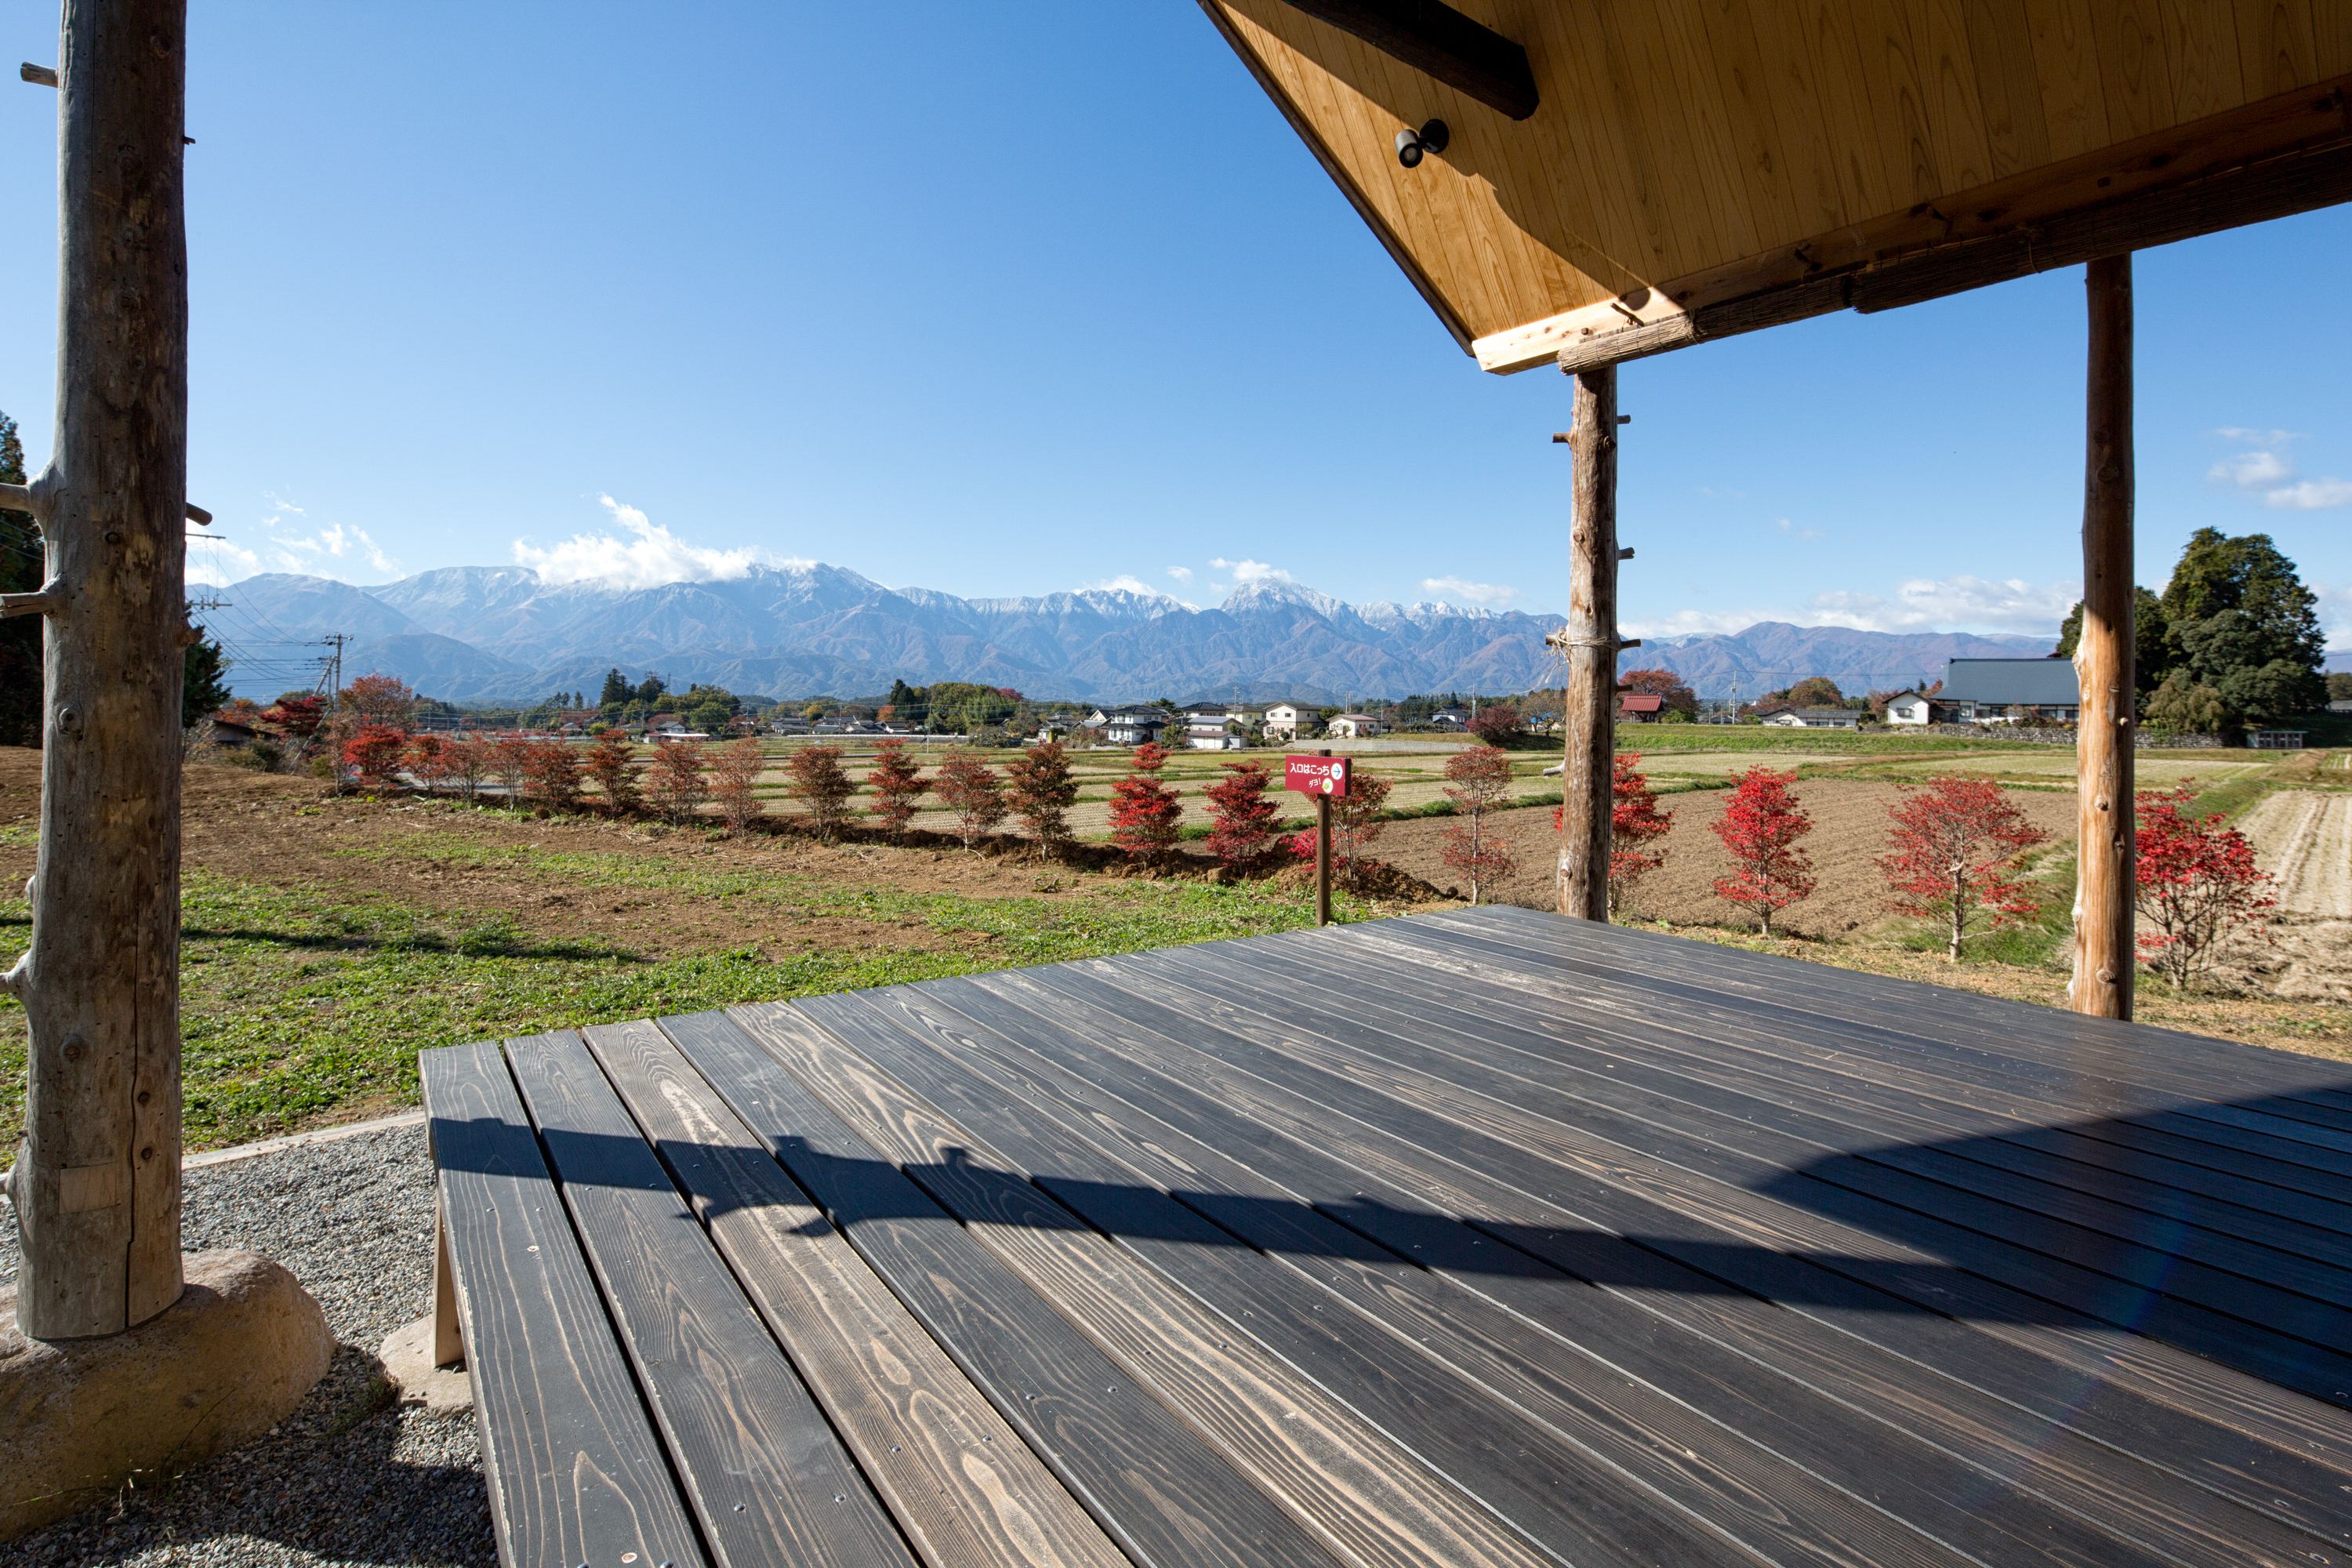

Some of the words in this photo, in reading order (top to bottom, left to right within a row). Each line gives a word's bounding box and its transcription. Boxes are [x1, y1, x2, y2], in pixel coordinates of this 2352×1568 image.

[1290, 763, 1330, 775] 入口はこっち
